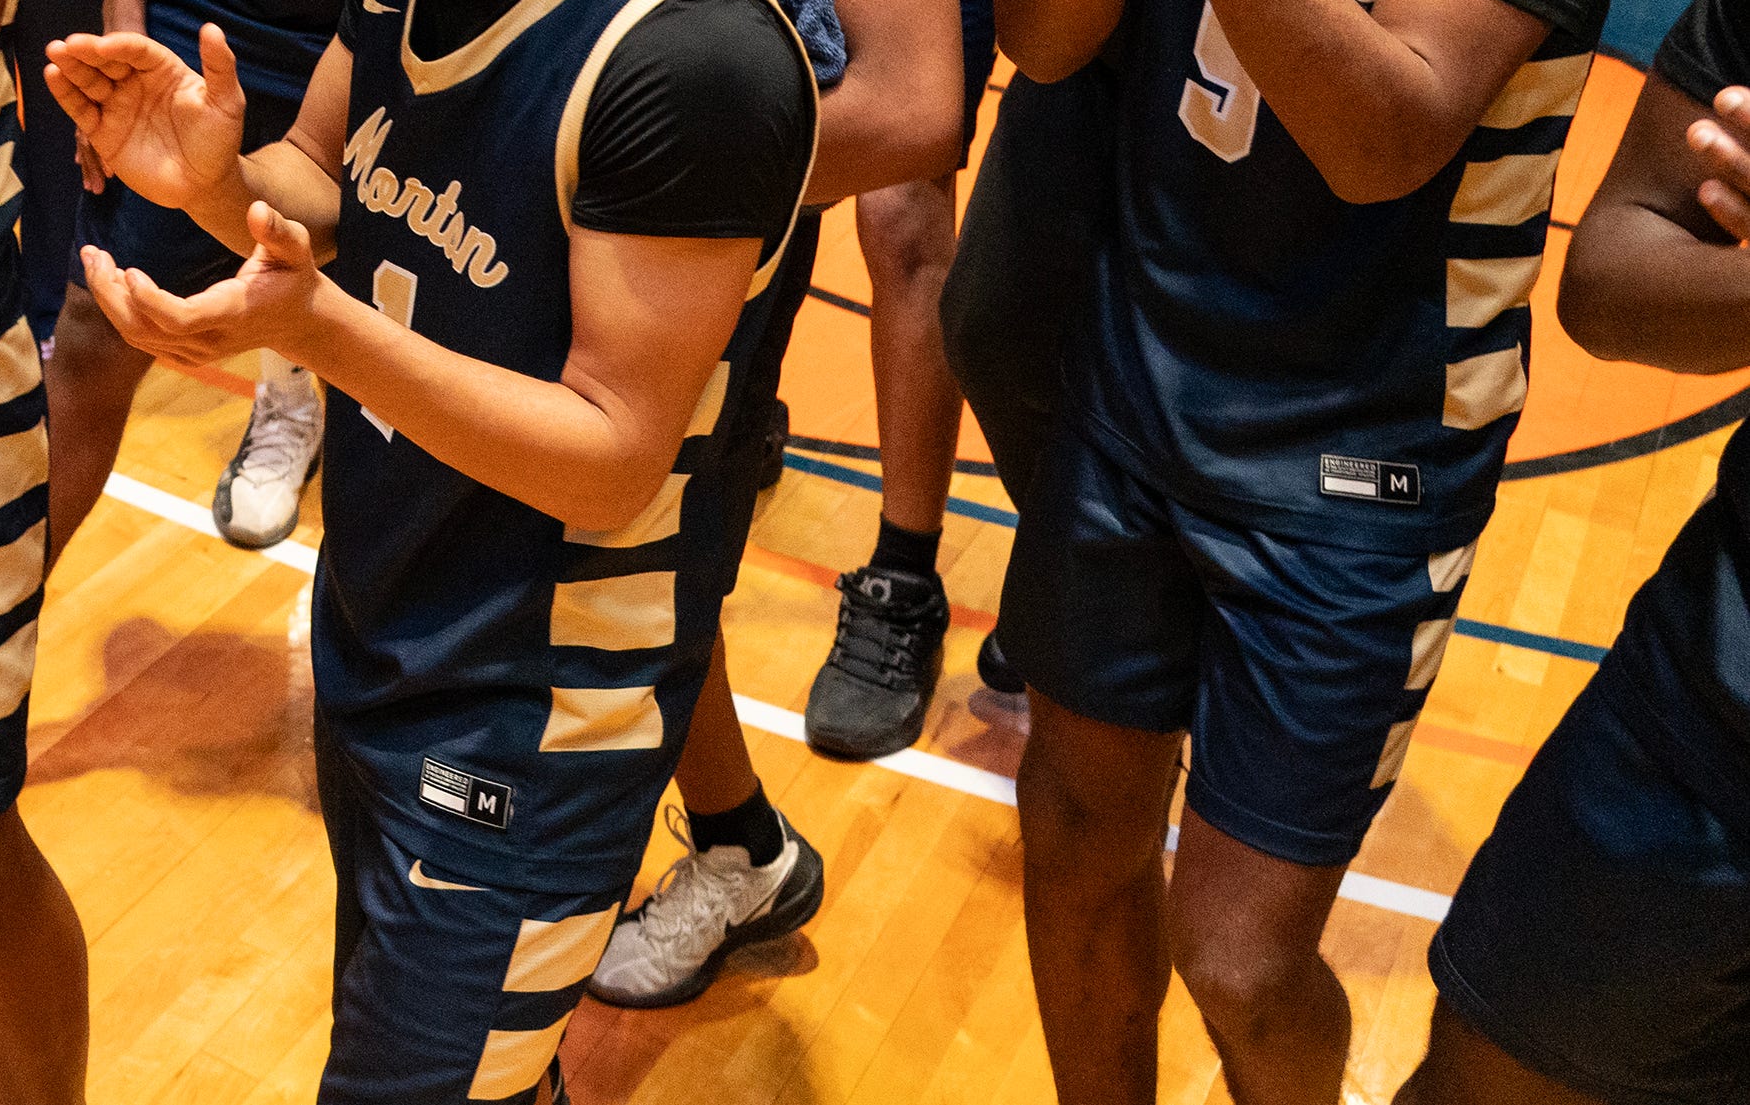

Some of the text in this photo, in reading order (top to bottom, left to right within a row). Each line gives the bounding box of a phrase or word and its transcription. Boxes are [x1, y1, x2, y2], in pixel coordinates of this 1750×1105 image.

[342, 105, 510, 288] Morton
[1389, 472, 1409, 494] M
[477, 791, 498, 815] M
